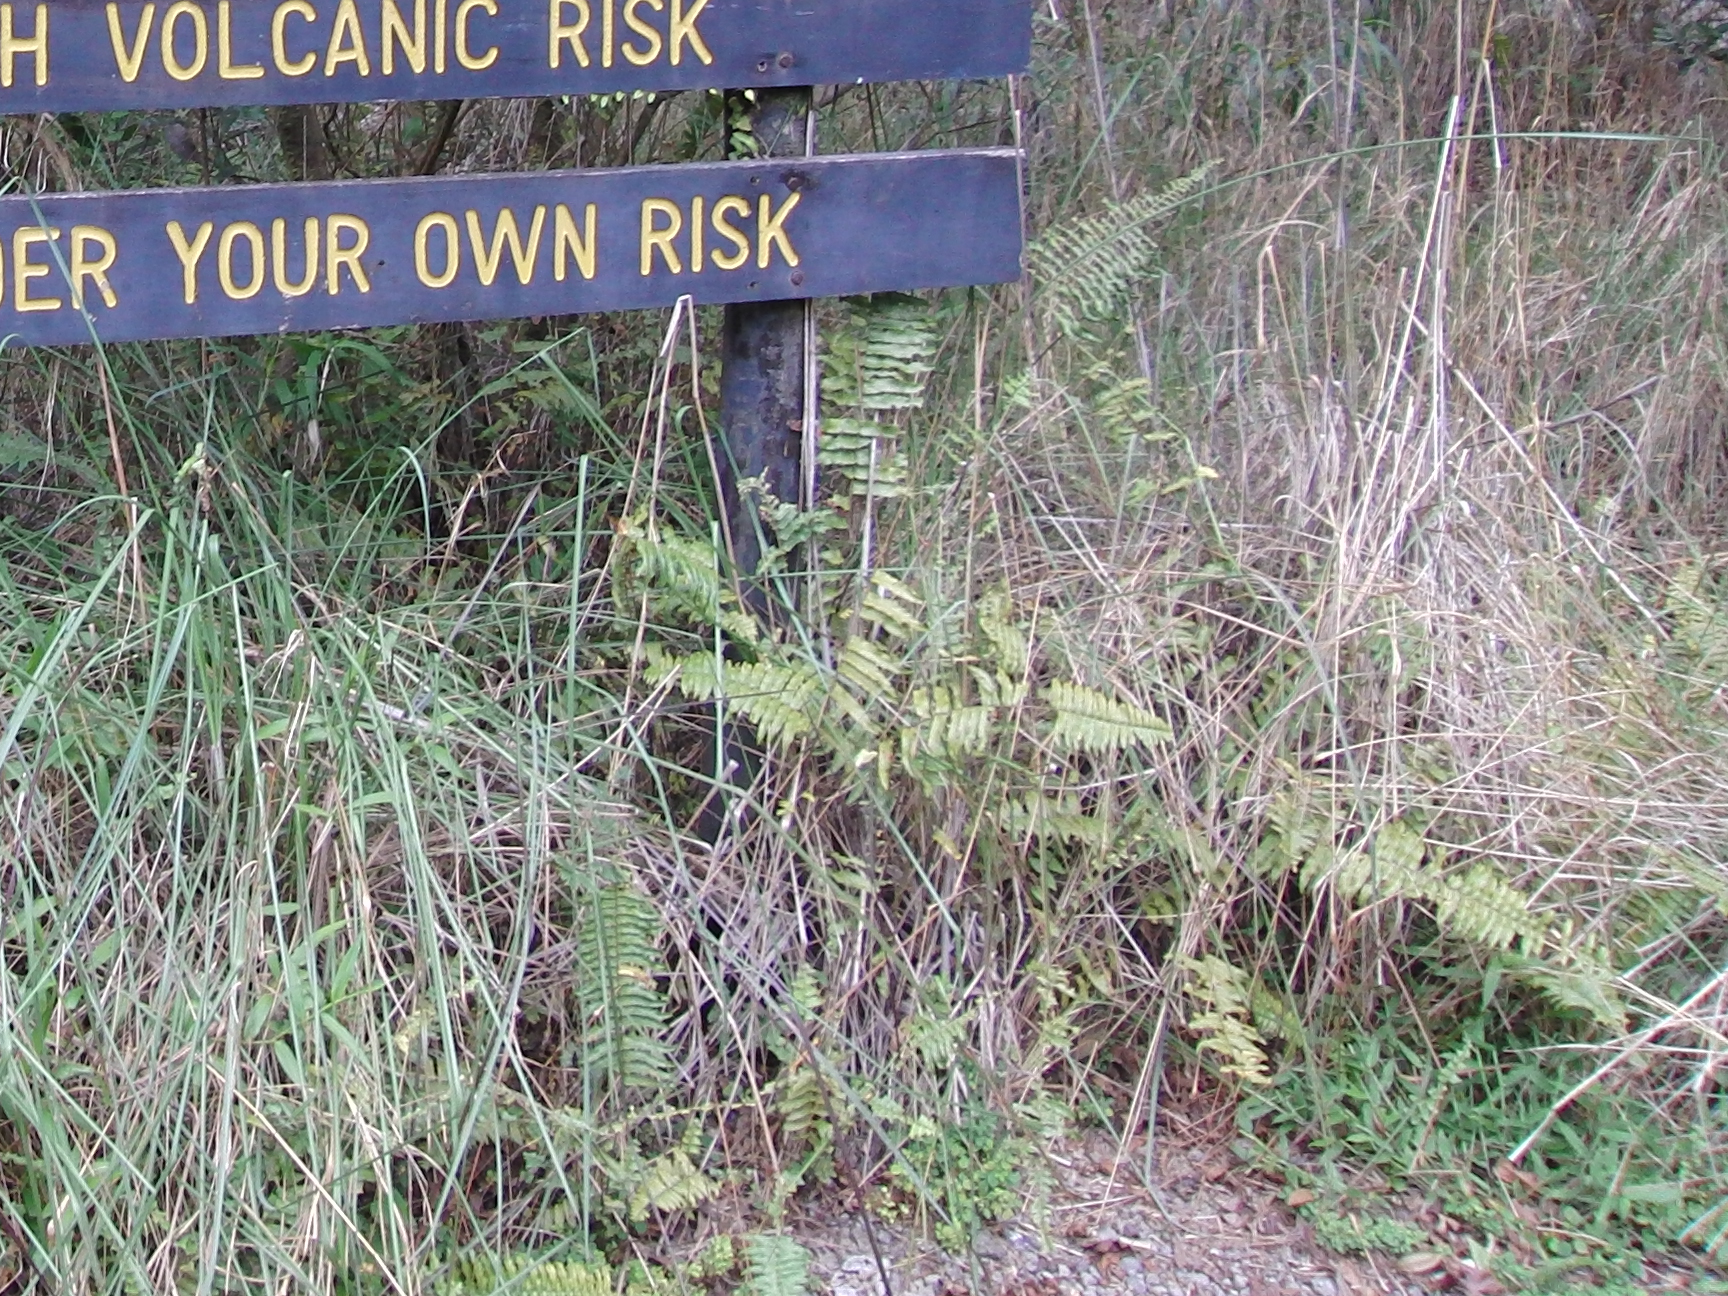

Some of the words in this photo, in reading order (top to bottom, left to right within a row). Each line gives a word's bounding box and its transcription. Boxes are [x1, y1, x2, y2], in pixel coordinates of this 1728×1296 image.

[167, 213, 371, 303] YOUR
[414, 203, 597, 287] OWN
[640, 191, 801, 274] RISK
